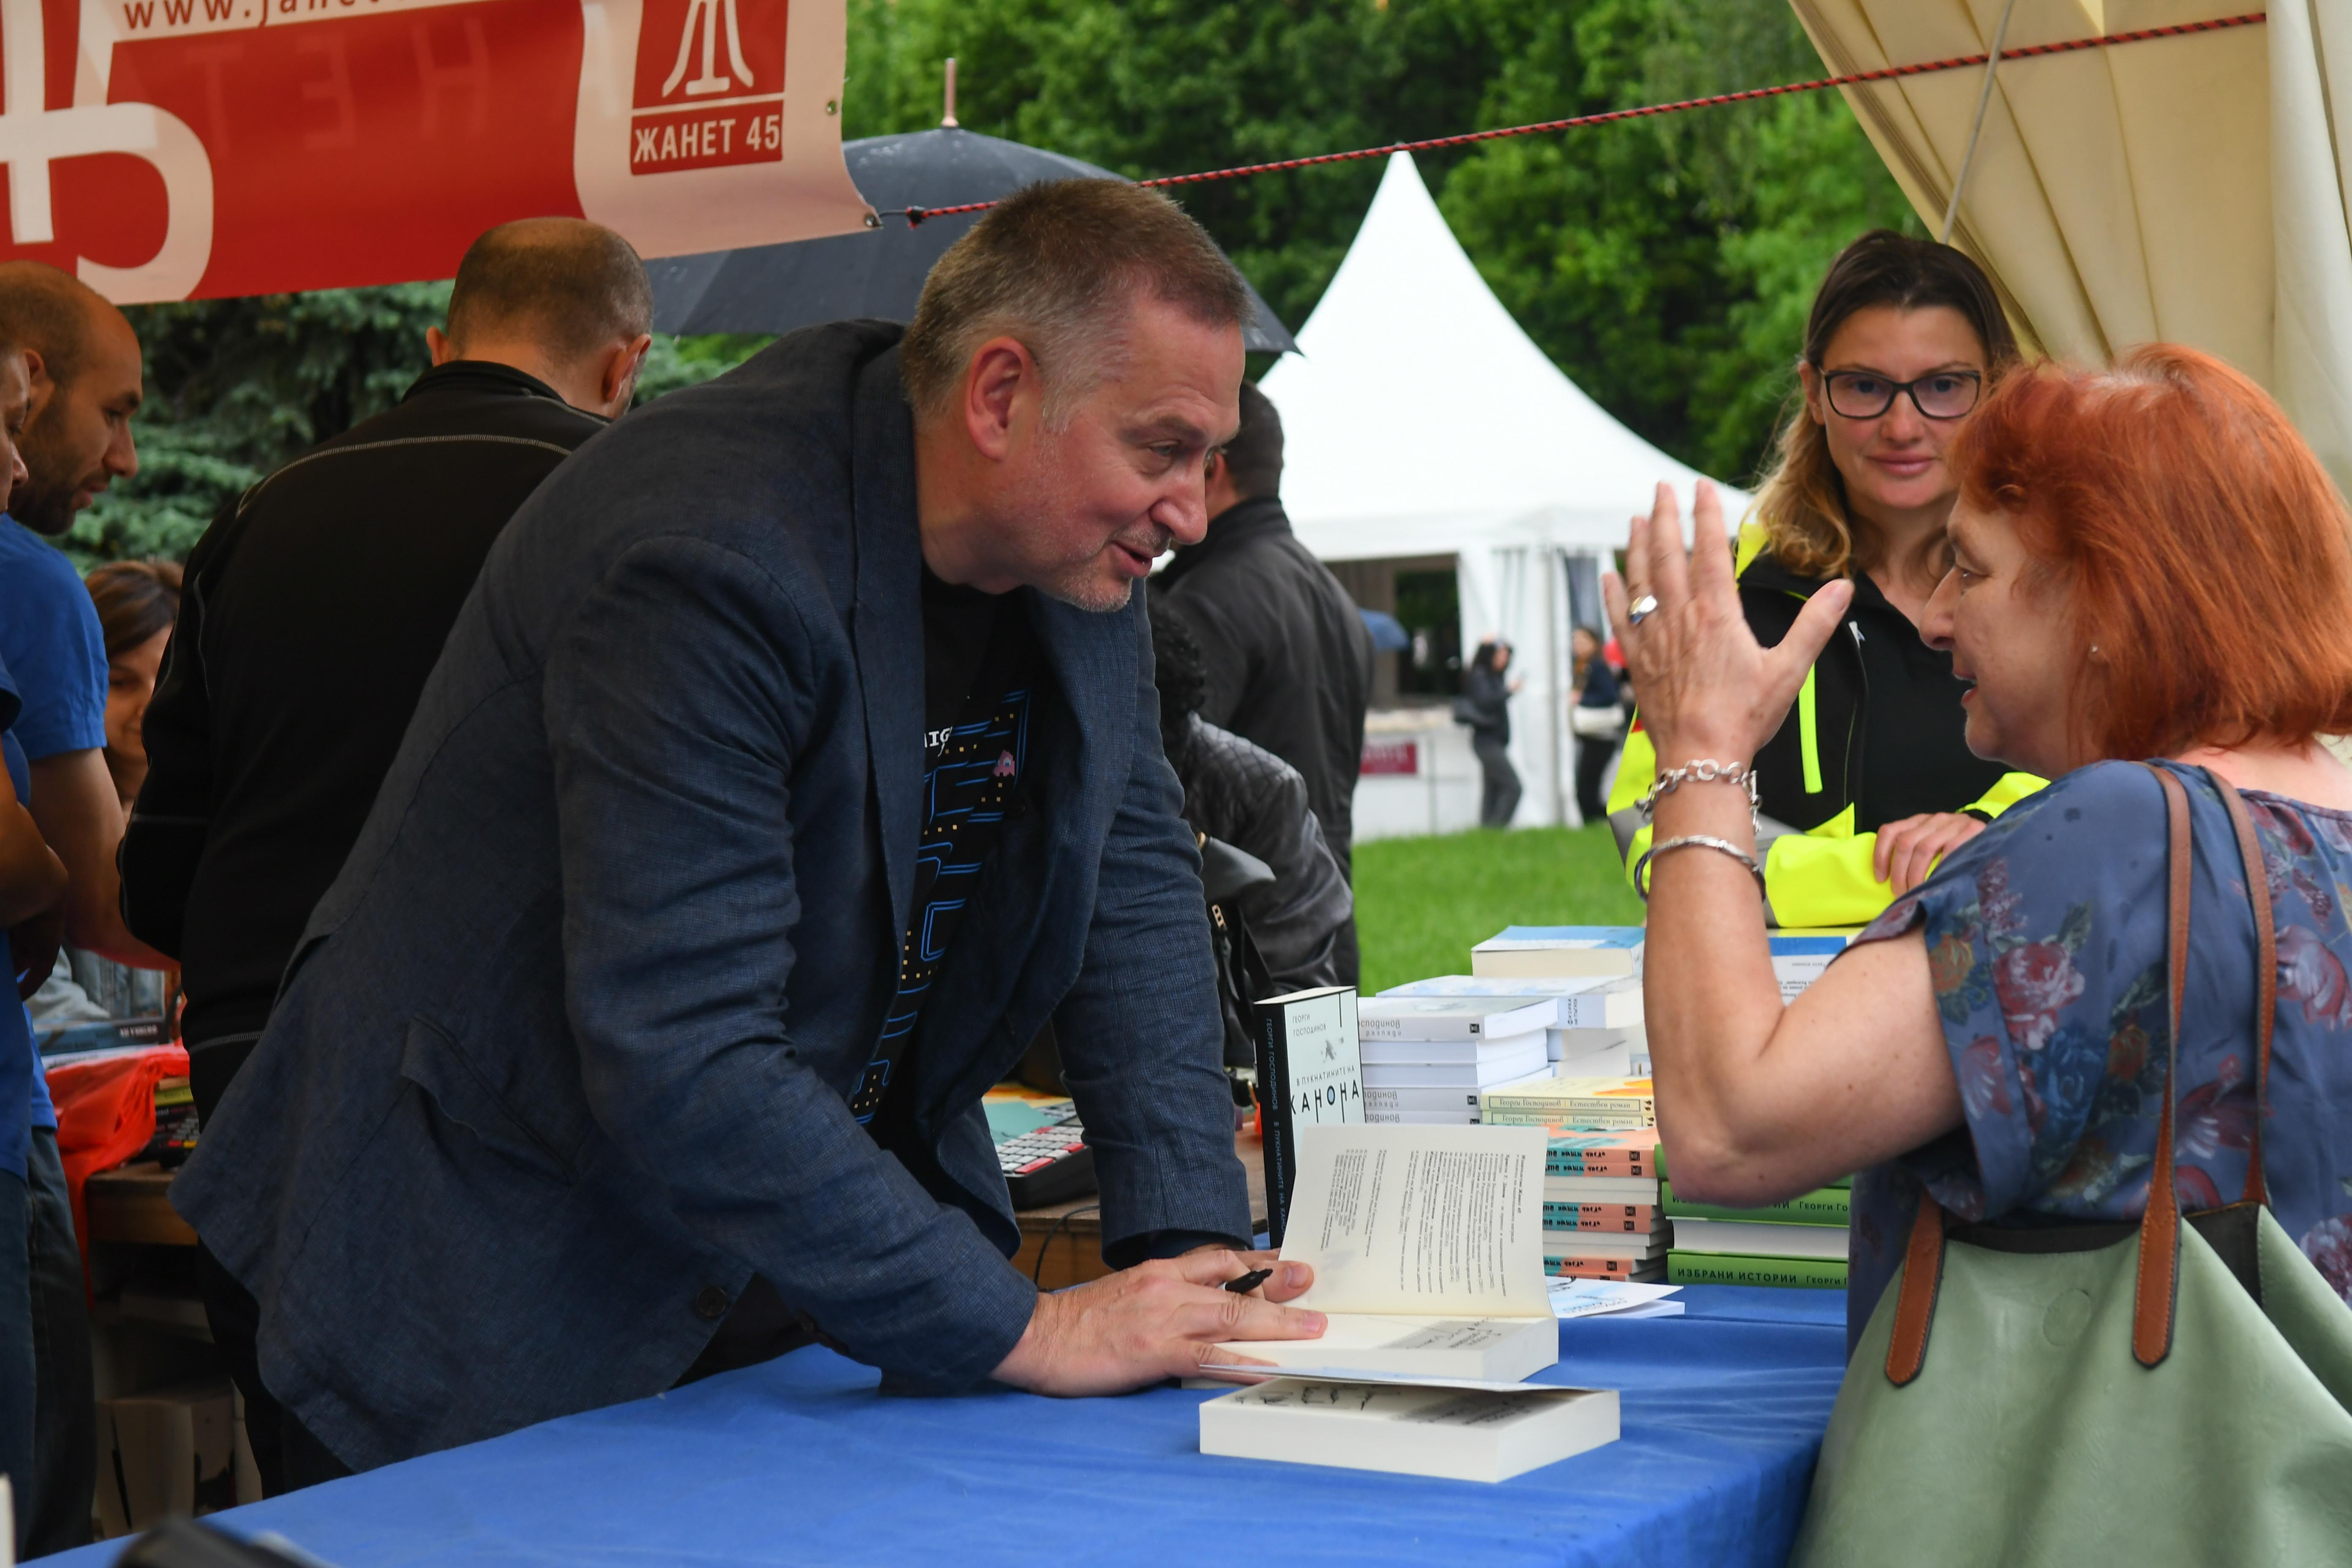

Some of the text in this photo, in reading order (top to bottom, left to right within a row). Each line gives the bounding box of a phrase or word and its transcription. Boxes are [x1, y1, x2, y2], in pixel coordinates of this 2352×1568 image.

[633, 114, 780, 163] ЖАНЕТ 45
[1293, 1014, 1310, 1024] ГЕОРГИ
[1358, 1019, 1400, 1029] сподинов
[1293, 1023, 1326, 1037] ГОСПОДИНОВ
[1296, 1065, 1355, 1087] В ПУКНАТИНИТЕ НА
[1290, 1079, 1359, 1122] КАНОНА
[1610, 1102, 1631, 1110] роман
[1269, 1052, 1278, 1111] ГОСПОДИНОВ
[1274, 1130, 1285, 1189] ПУКНАТИНИТЕ
[1612, 1118, 1633, 1126] роман
[1678, 1268, 1734, 1280] ИЗБРАНИ
[1738, 1271, 1797, 1284] ИСТОРИИ
